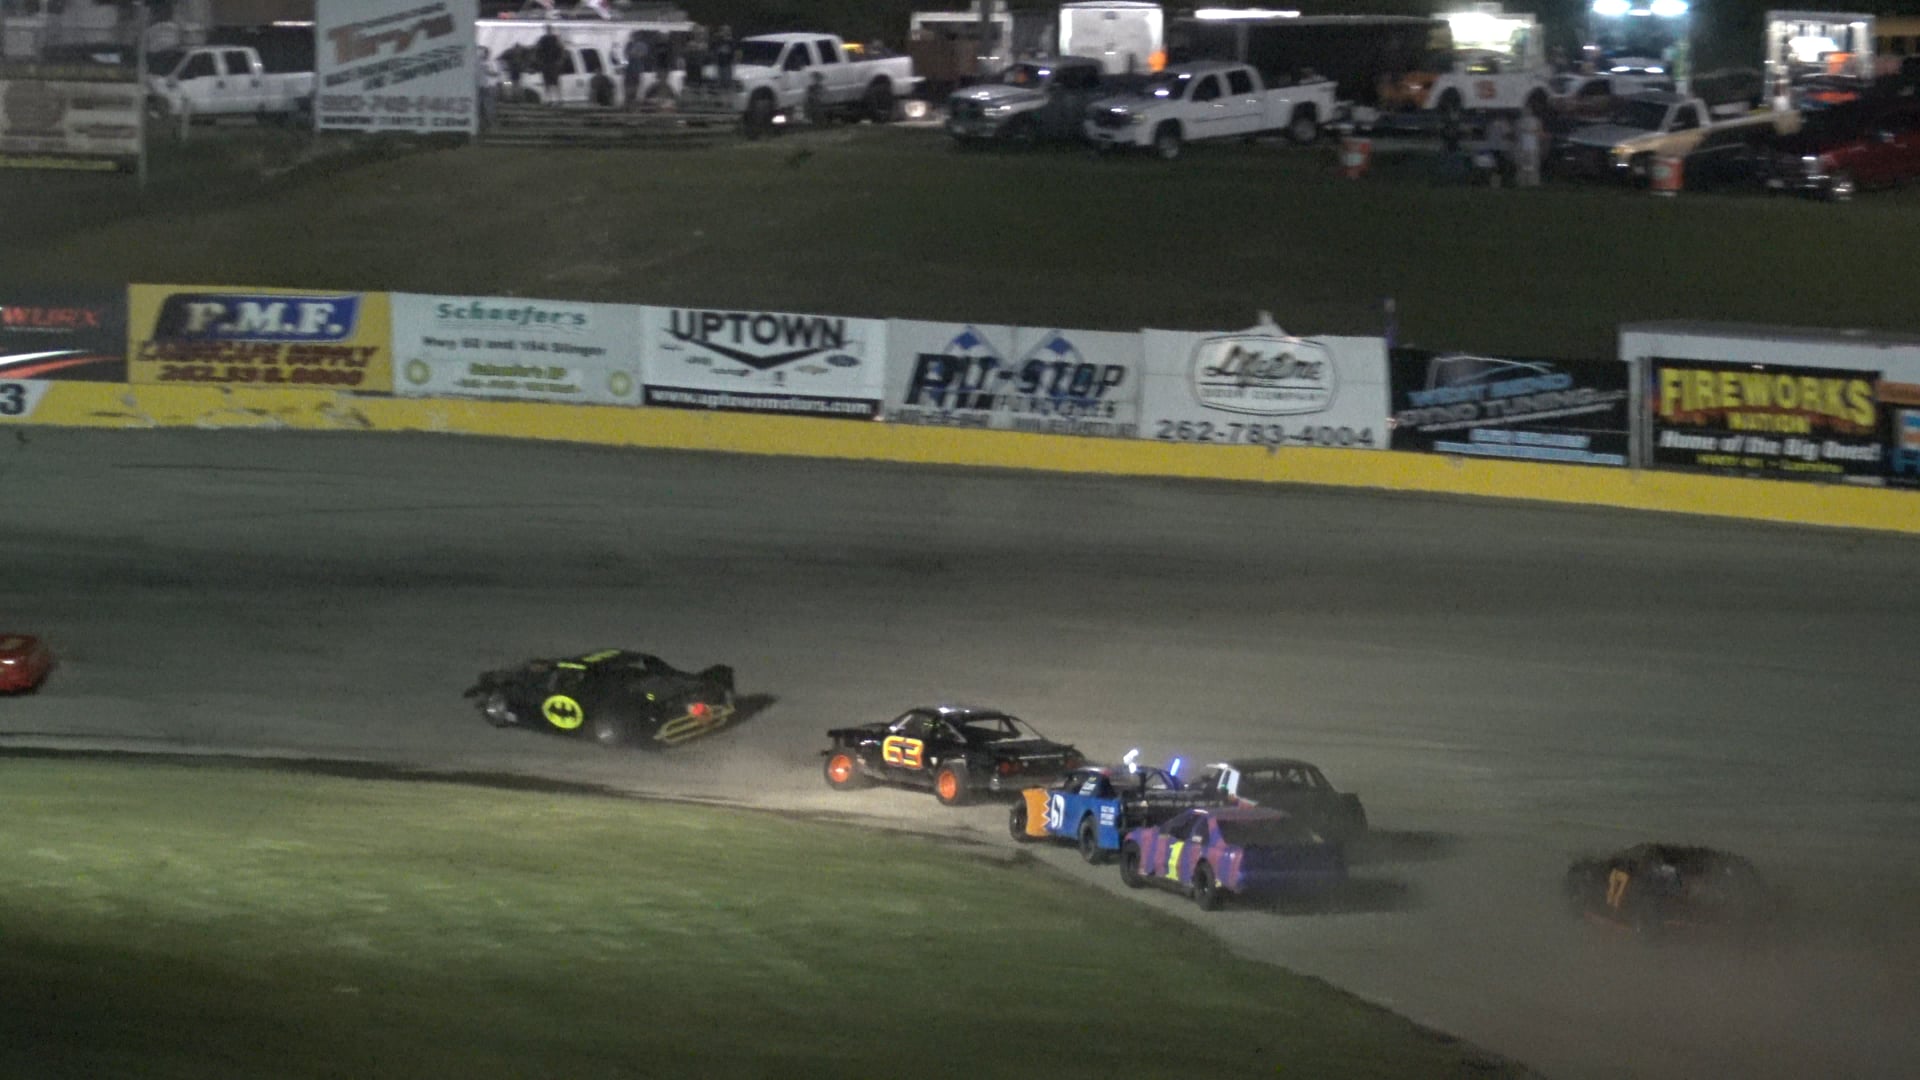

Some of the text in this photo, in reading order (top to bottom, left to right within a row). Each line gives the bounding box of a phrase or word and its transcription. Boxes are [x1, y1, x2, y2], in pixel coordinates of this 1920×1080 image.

[437, 301, 587, 326] Schaefer's
[670, 309, 846, 349] UPTOWN
[1658, 367, 1876, 427] FIREWORKS
[1155, 419, 1376, 447] 262-783-4004
[1659, 430, 1717, 449] Home
[1784, 439, 1819, 460] Big
[882, 735, 924, 770] 63
[1165, 841, 1184, 881] 1
